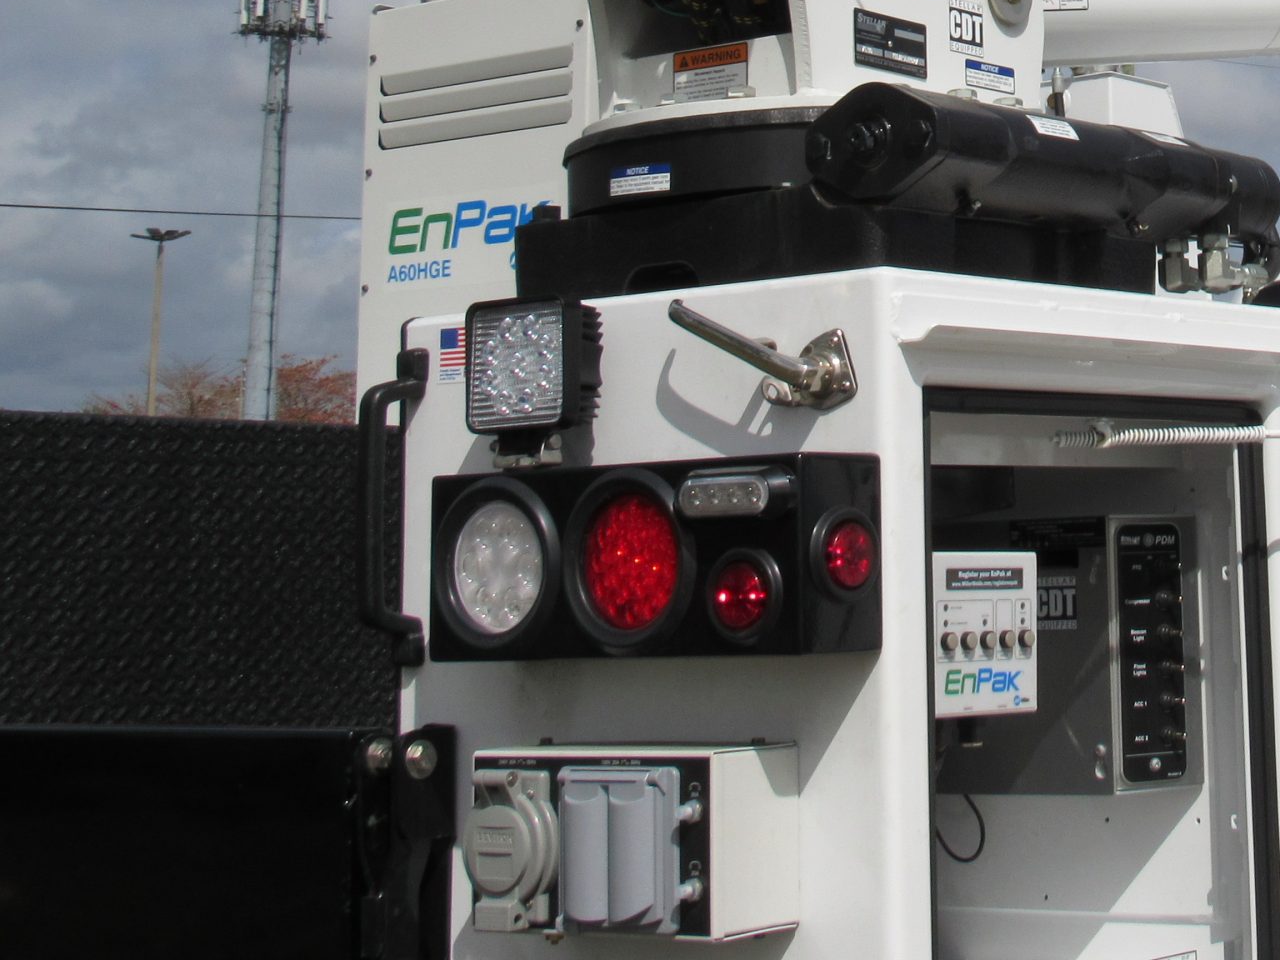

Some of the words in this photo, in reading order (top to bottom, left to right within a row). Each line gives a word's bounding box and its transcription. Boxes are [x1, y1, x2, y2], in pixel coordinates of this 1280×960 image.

[857, 12, 887, 28] STELLAR
[950, 9, 983, 43] CDT
[950, 41, 983, 56] EQUIPPED
[691, 49, 741, 65] WARNING
[980, 64, 999, 74] NOTICE
[626, 166, 649, 176] NOTICE
[387, 259, 452, 283] A60HGE
[1155, 535, 1176, 545] PDM
[944, 667, 1022, 695] EnPak
